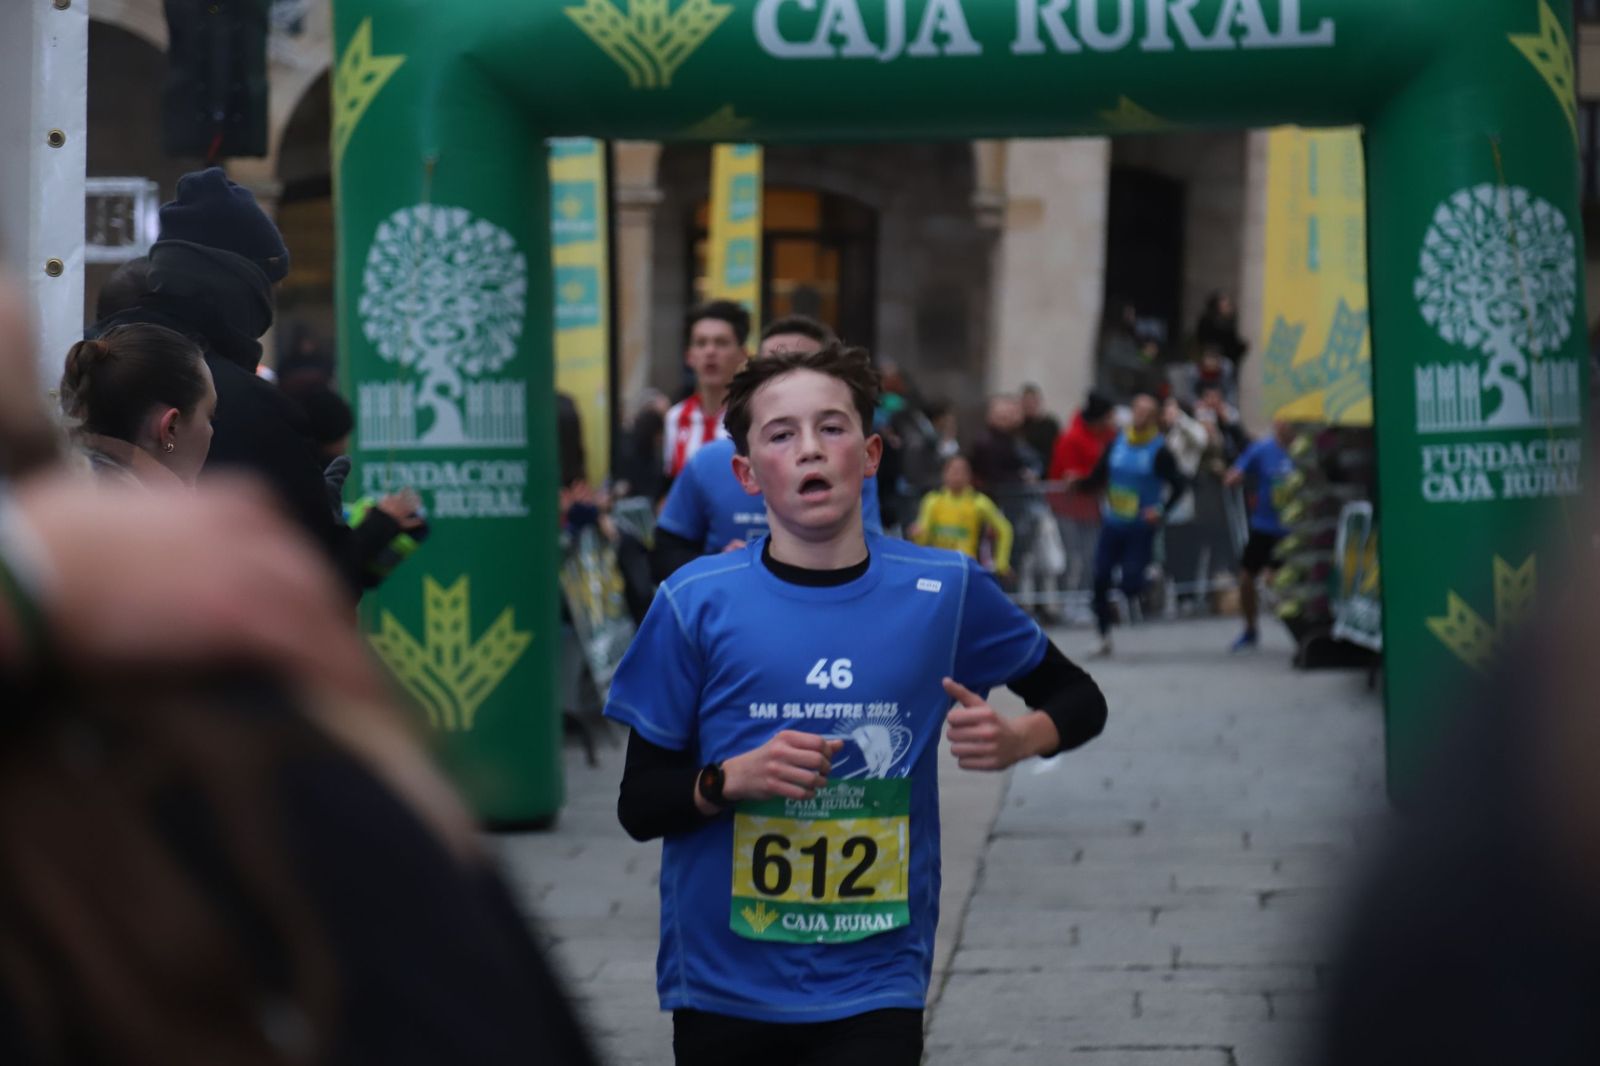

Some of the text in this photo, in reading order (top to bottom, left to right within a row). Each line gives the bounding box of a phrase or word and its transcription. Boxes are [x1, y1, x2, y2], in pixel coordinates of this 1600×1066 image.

[753, 0, 1335, 62] CAJA RURAL
[1422, 439, 1581, 472] FUNDACION
[362, 460, 527, 490] FUNDACION
[1422, 466, 1582, 503] CAJA RURAL
[434, 486, 528, 517] RURAL
[806, 658, 853, 689] 46
[749, 702, 898, 719] SAN SILVESTRE 2025
[821, 796, 864, 810] RURAL
[752, 833, 878, 899] 612
[782, 912, 897, 932] CAJA RURAL
